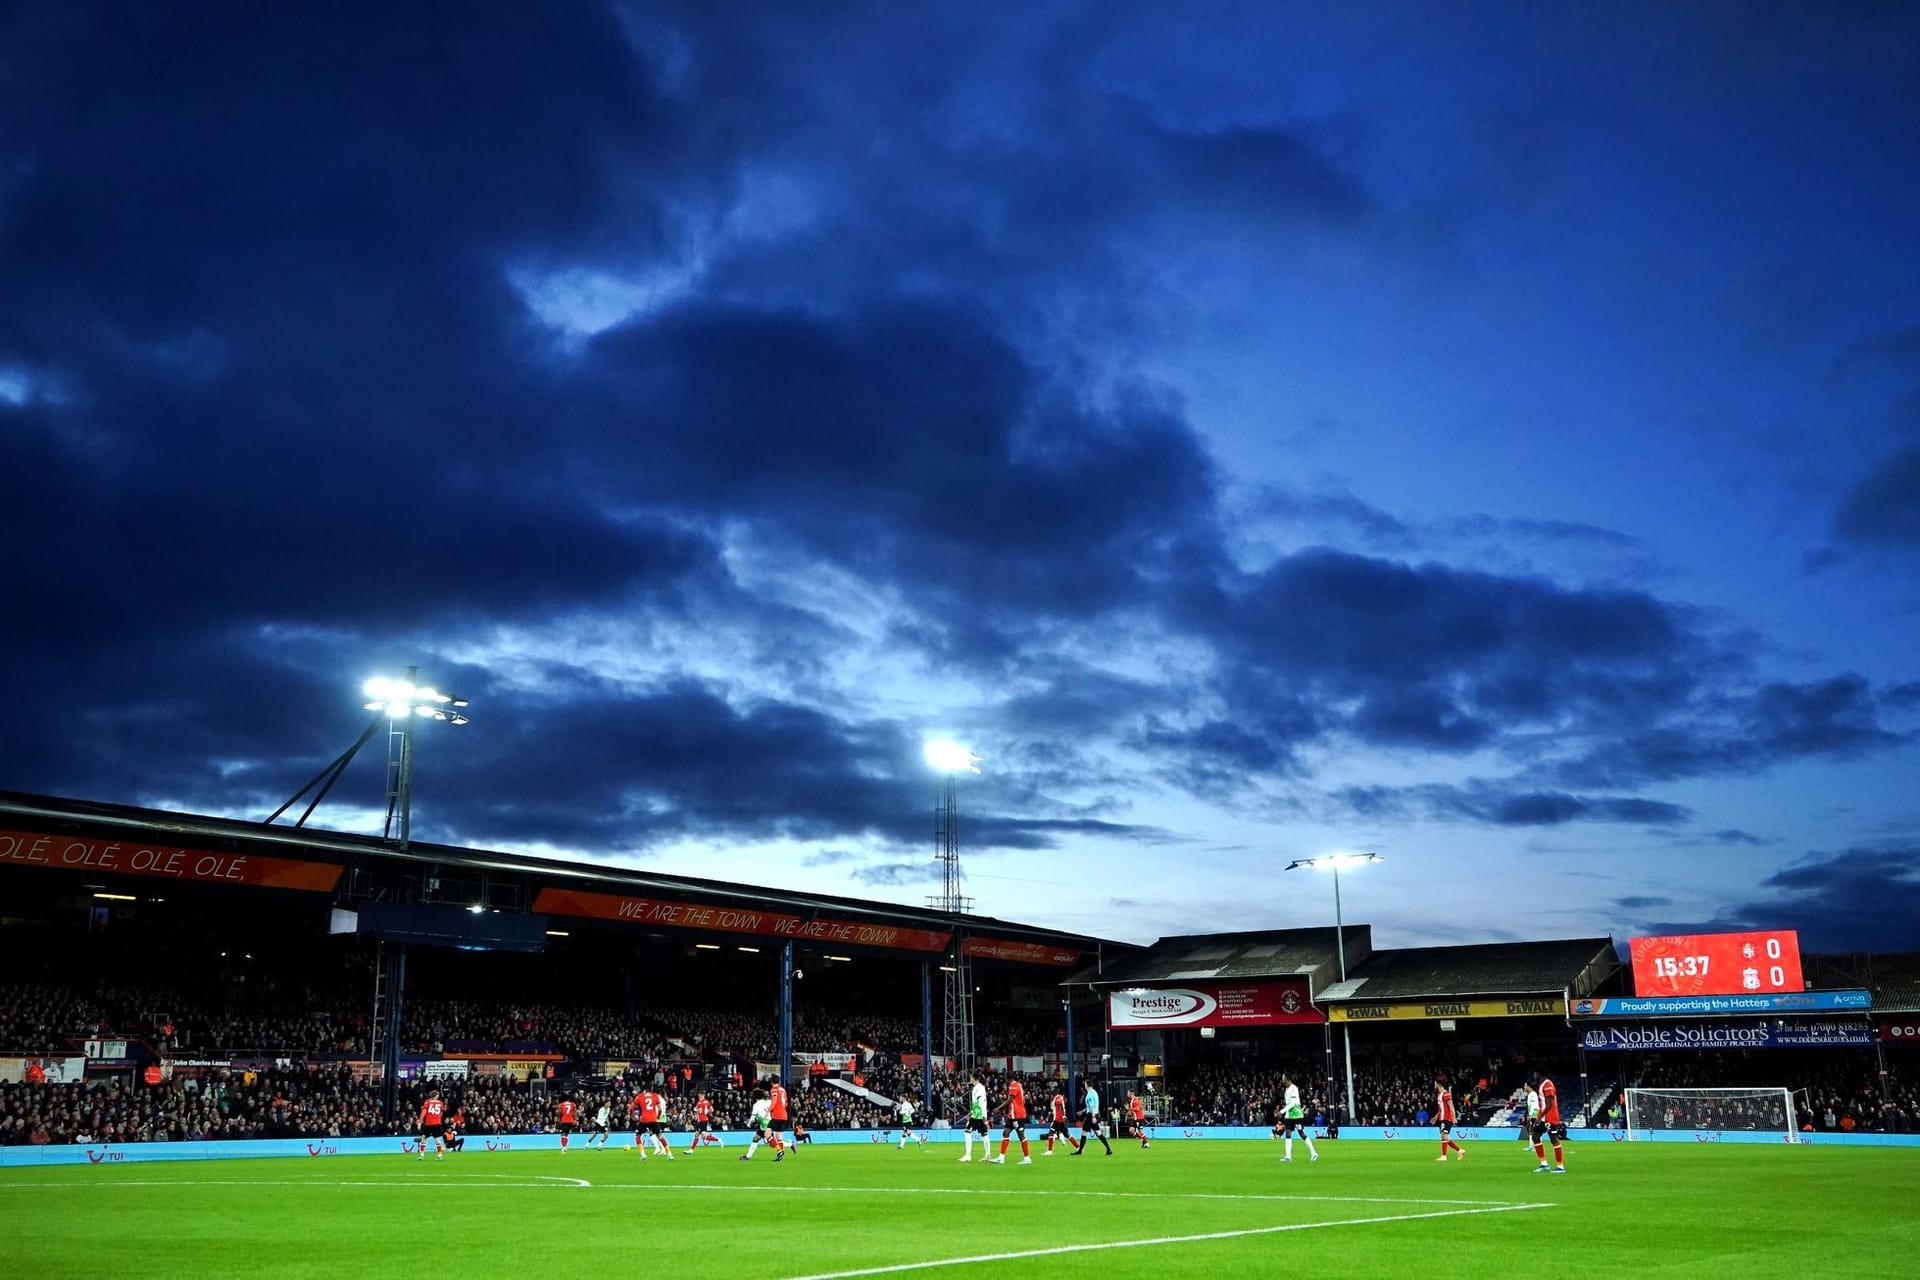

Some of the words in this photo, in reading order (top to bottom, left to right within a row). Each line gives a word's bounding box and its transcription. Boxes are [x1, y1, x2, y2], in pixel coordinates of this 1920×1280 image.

[63, 843, 120, 870] OLÉ,
[131, 850, 185, 876] OLÉ,
[195, 856, 246, 881] OLÉ,
[619, 900, 648, 918] WE
[648, 903, 682, 922] ARE
[683, 908, 717, 925] THE
[717, 911, 762, 930] TOWN
[774, 918, 799, 935] WE
[799, 921, 829, 937] ARE
[829, 924, 855, 940] THE
[1766, 938, 1781, 960] 0
[1655, 955, 1710, 978] 15:37
[1770, 965, 1785, 987] 0
[1132, 996, 1181, 1010] Prestige
[1621, 1001, 1657, 1013] Proudly
[1659, 1000, 1711, 1012] supporting
[1712, 999, 1729, 1010] the
[1730, 998, 1770, 1010] Hatters
[1610, 1026, 1671, 1043] Noble
[1675, 1023, 1769, 1042] Solicitors
[428, 1103, 441, 1115] 45
[565, 1103, 572, 1115] 7
[645, 1097, 654, 1111] 2
[325, 1146, 337, 1155] TUI
[501, 1142, 511, 1150] TUI
[109, 1152, 124, 1161] TUI
